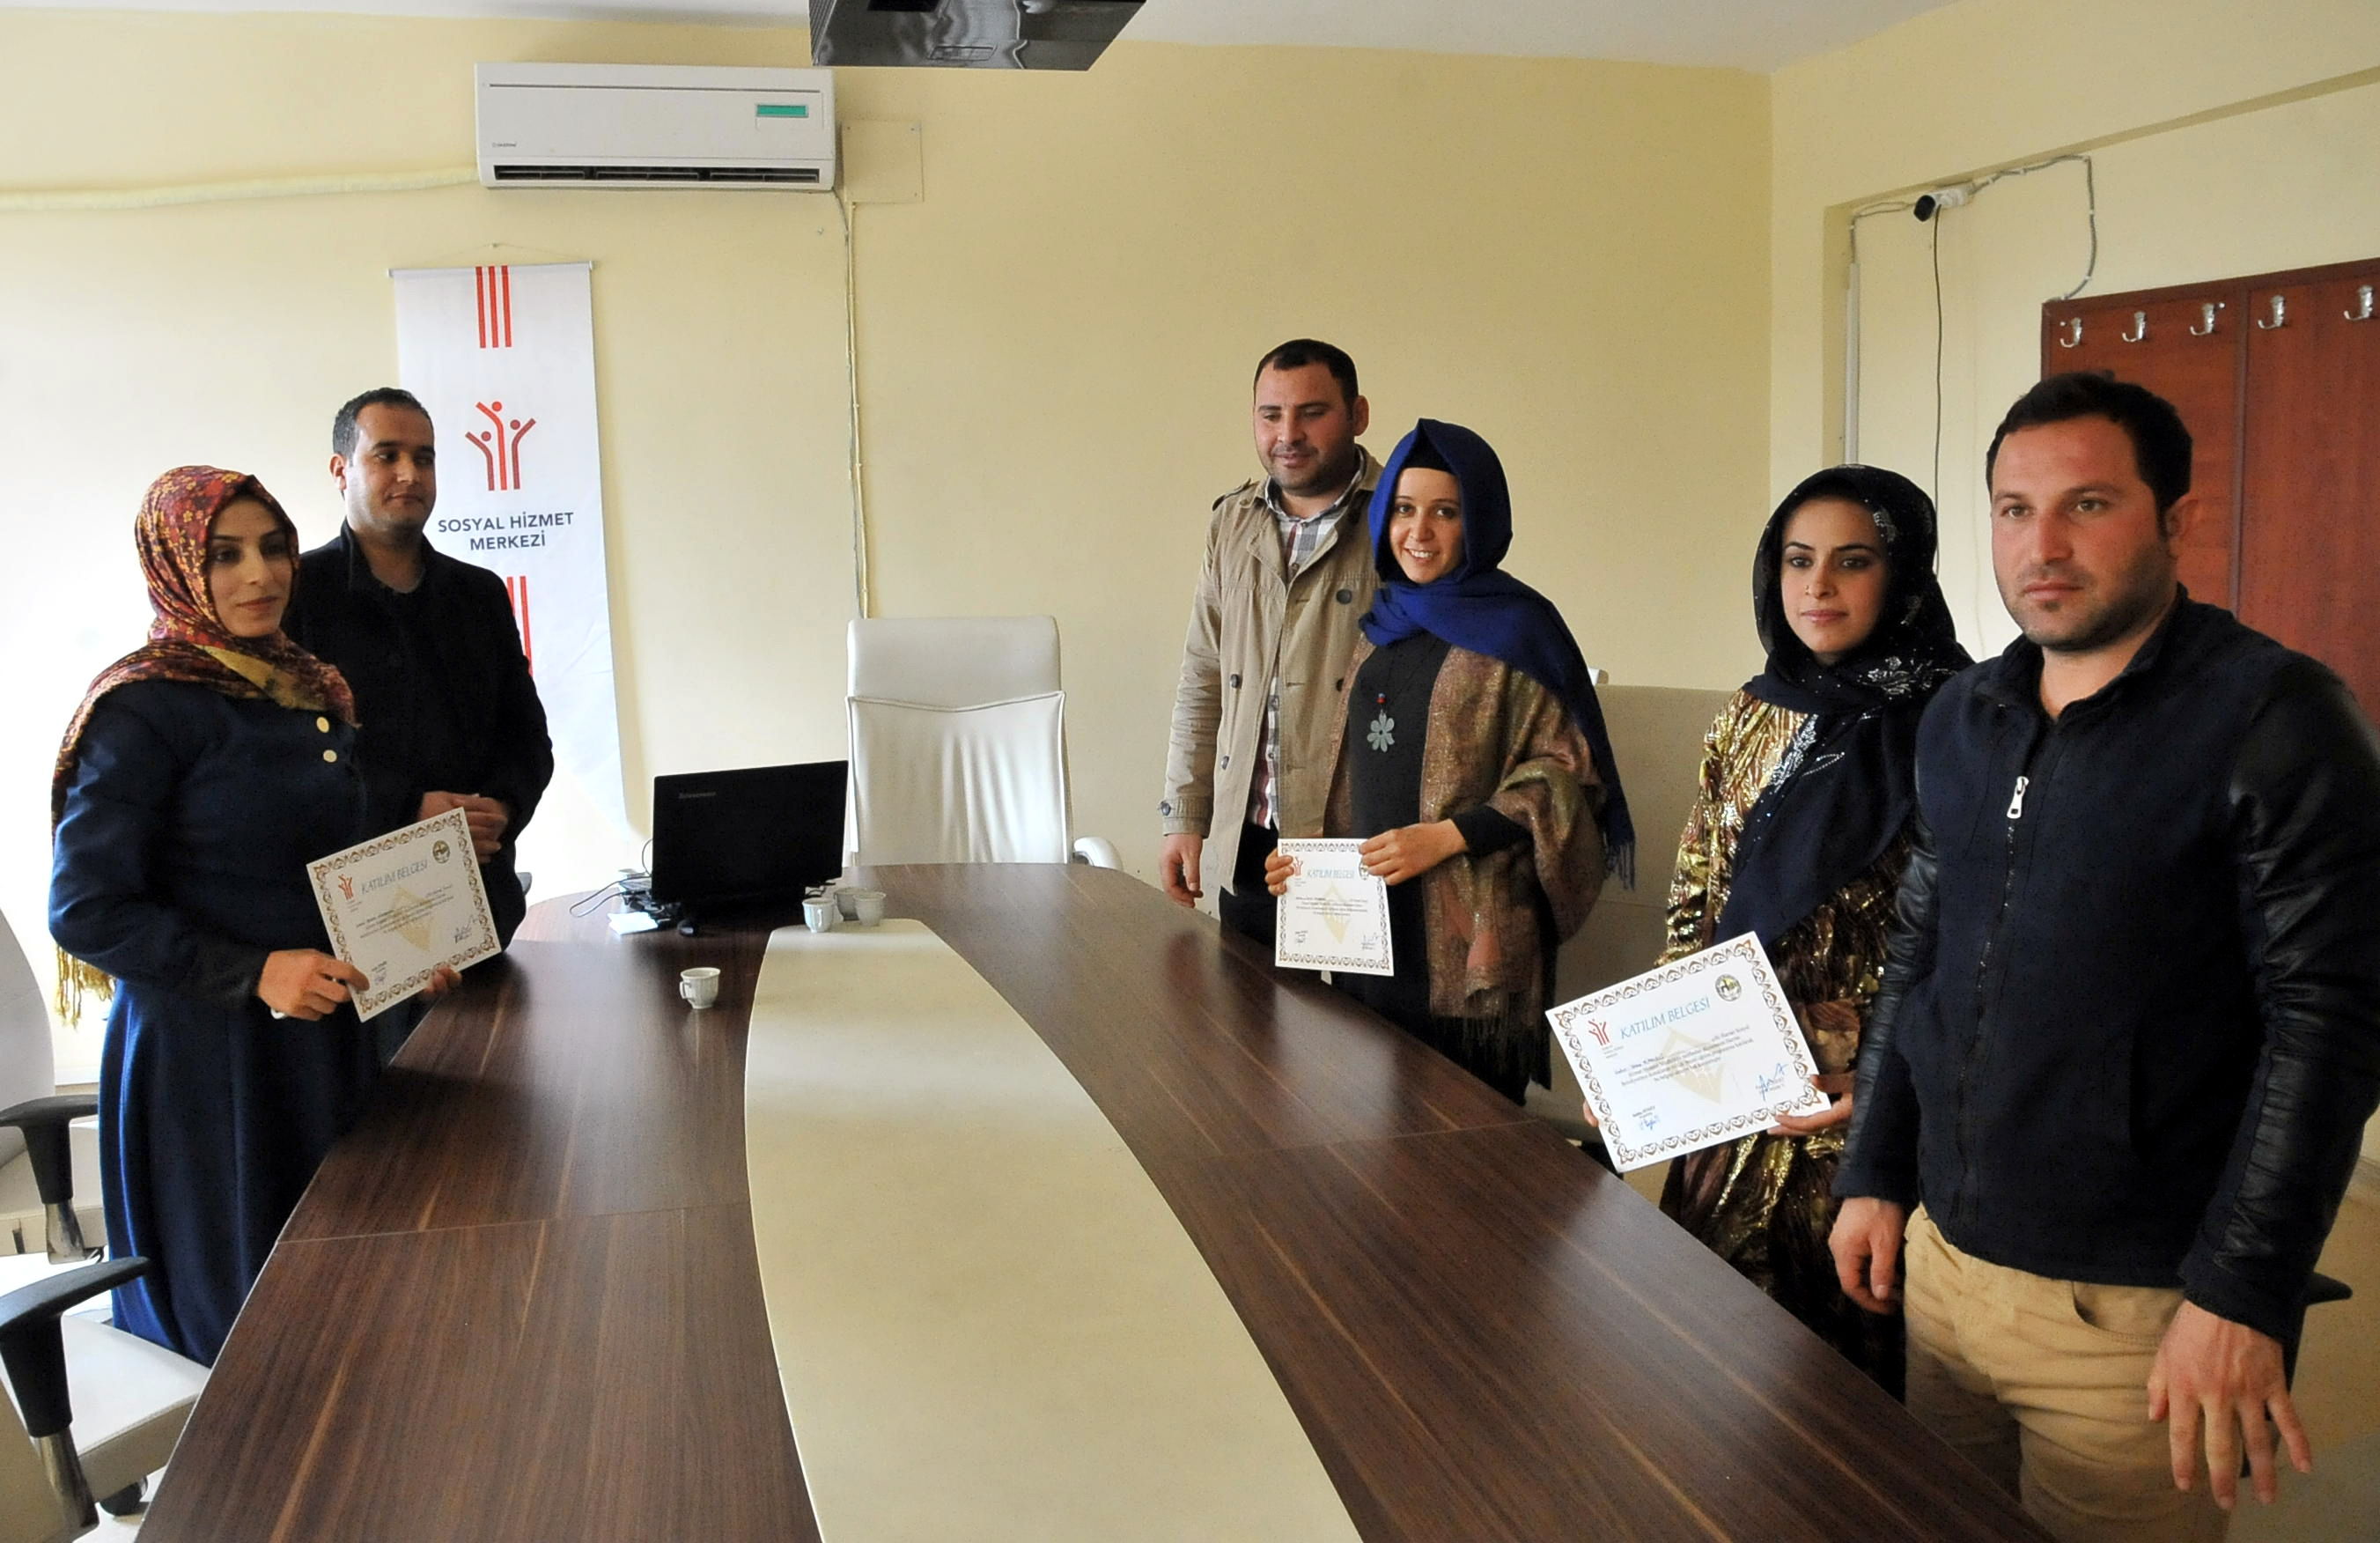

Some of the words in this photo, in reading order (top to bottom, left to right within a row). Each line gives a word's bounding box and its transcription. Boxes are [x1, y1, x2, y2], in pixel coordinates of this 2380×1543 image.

[438, 517, 505, 533] SOSYAL
[510, 511, 574, 528] HİZMET
[469, 529, 546, 550] MERKEZİ
[361, 871, 395, 895] KATILIM
[1620, 1012, 1666, 1039] KATILIM
